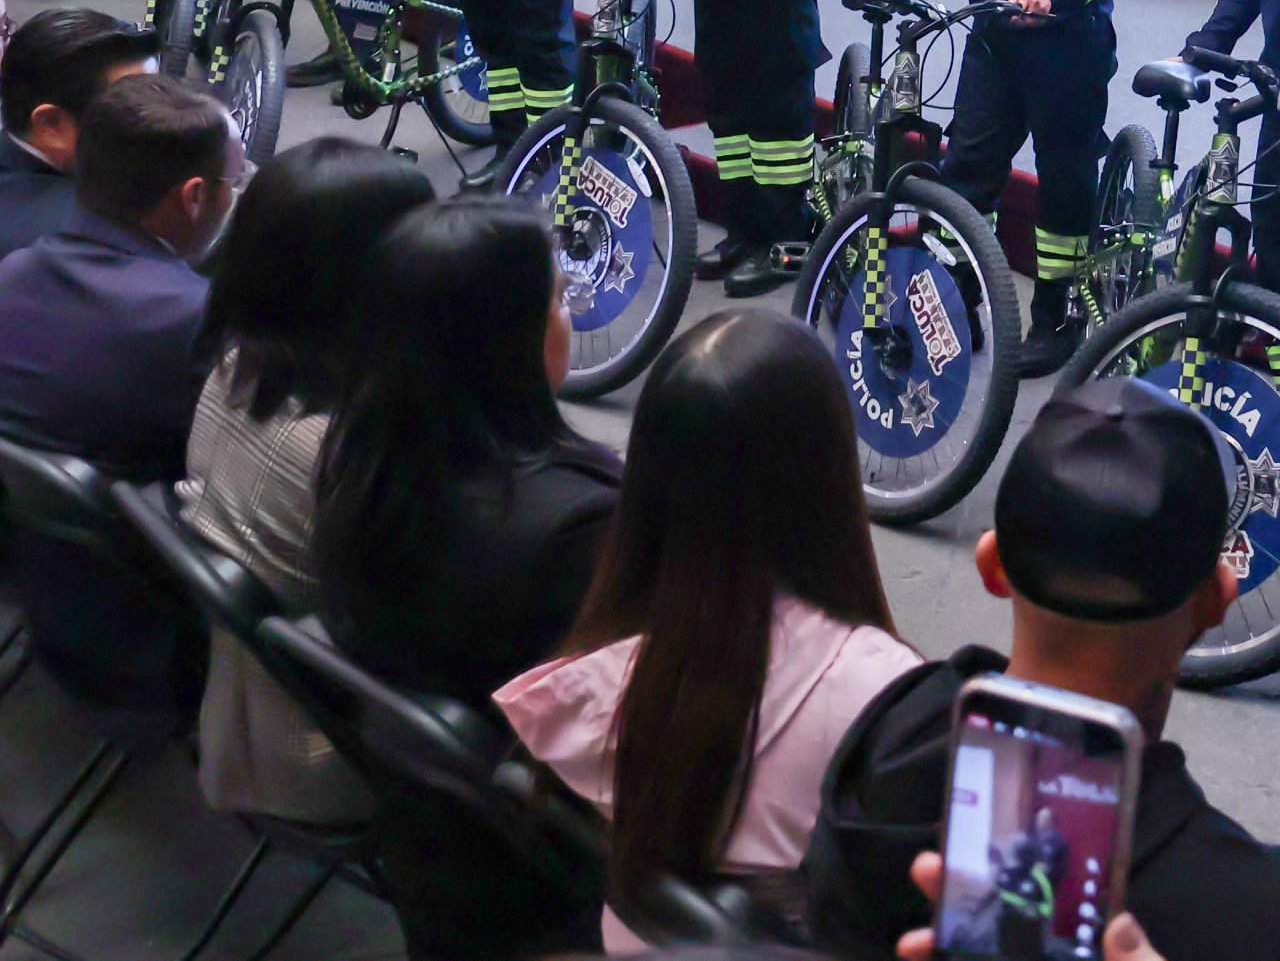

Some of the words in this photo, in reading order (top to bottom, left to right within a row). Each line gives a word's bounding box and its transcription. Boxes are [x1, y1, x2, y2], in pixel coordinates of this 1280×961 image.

[578, 170, 628, 226] TOLUCA
[908, 279, 947, 373] TOLUCA
[847, 330, 894, 429] POLICÍA
